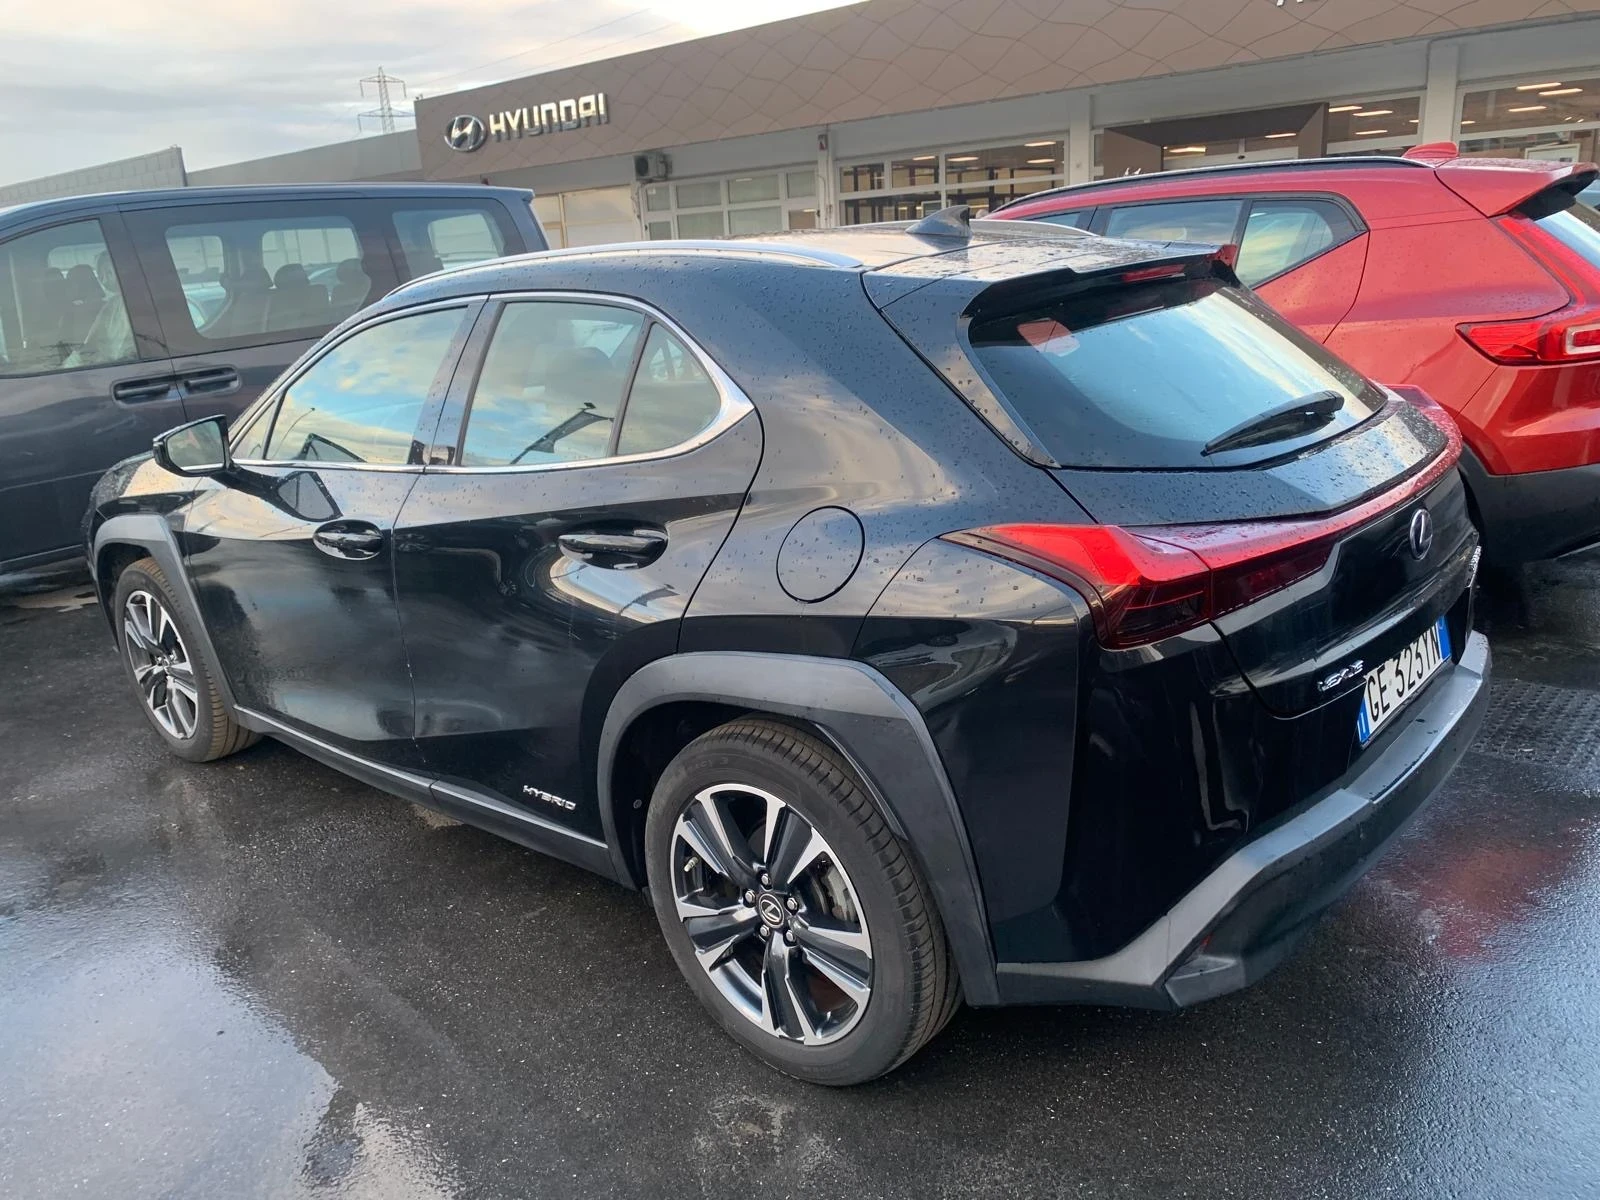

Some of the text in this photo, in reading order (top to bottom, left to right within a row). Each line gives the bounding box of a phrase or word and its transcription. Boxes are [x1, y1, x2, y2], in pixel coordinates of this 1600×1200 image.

[489, 93, 608, 142] HYUNDAI
[1367, 625, 1441, 722] GE 323YN
[523, 785, 577, 811] HYBRID
